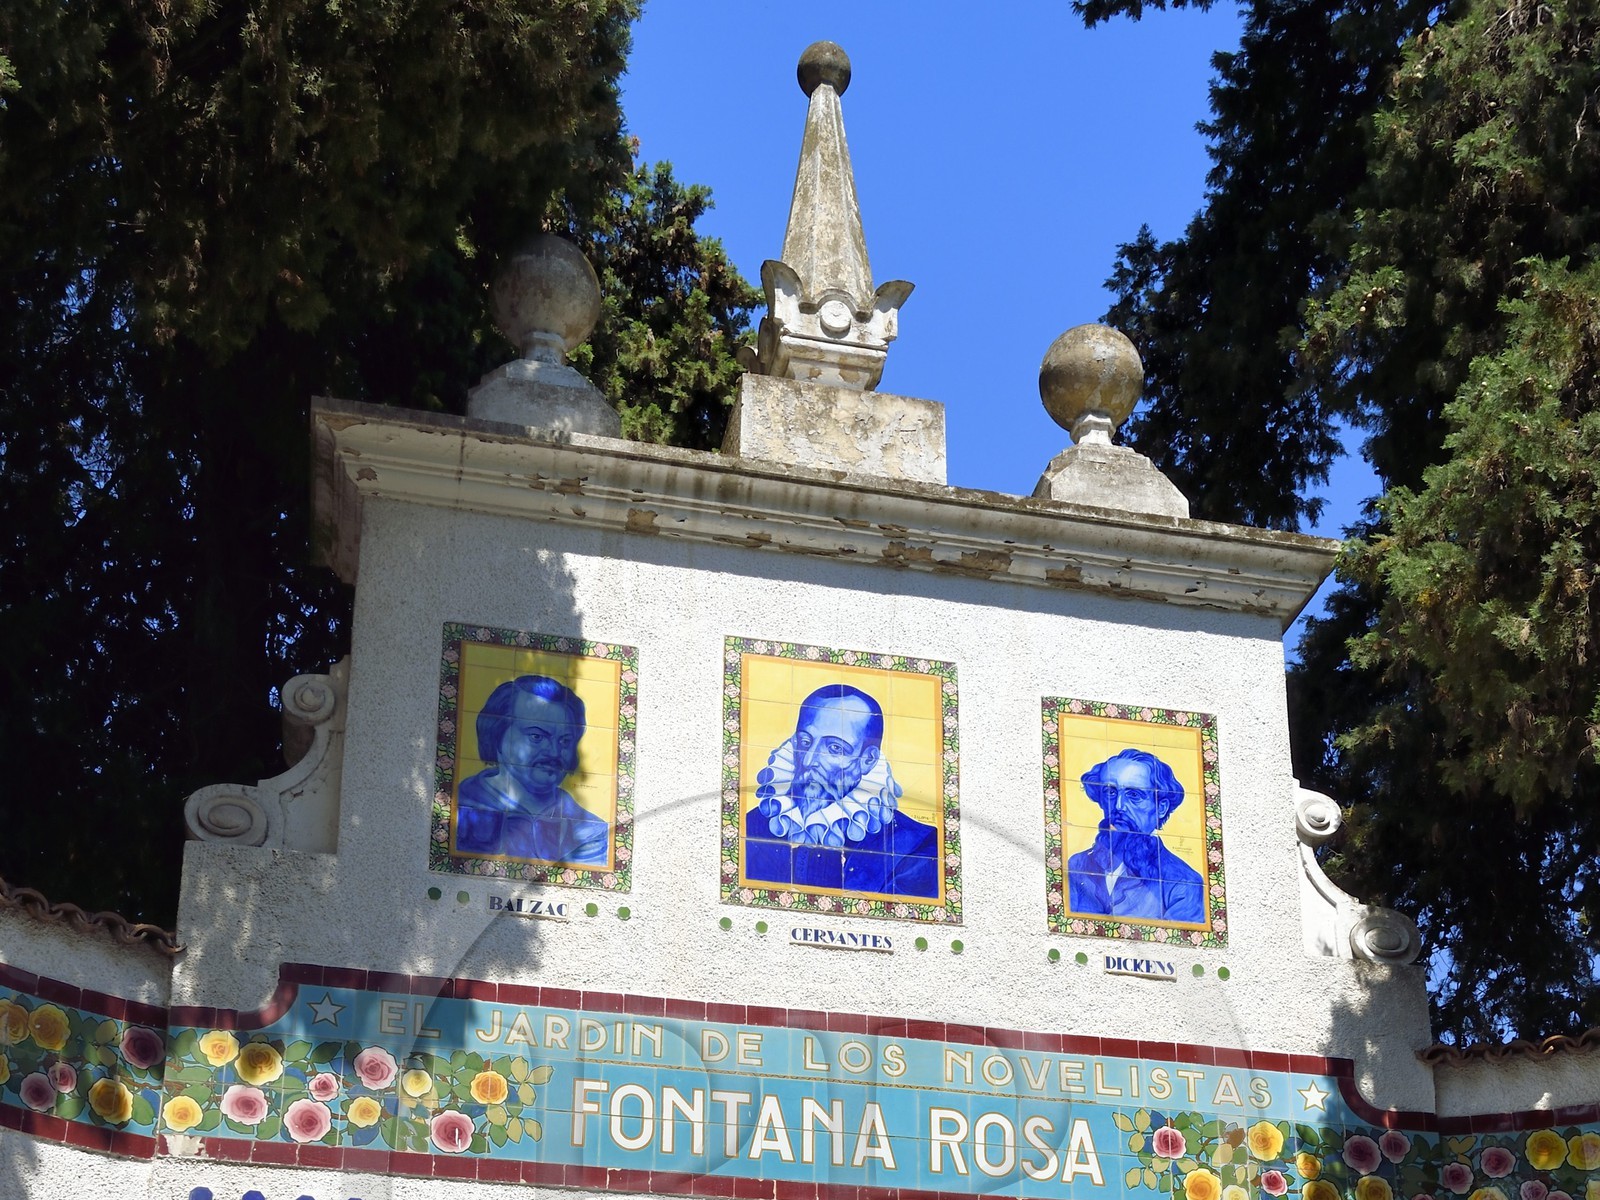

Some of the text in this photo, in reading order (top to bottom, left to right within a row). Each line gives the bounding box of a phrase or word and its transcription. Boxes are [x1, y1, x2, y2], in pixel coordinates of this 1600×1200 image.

[490, 896, 567, 916] BALZAC
[792, 927, 891, 948] CERVANTES
[1106, 956, 1175, 975] DICKENS
[379, 1000, 1272, 1109] EL JARDIN DE LOS NOVELISTAS
[571, 1078, 1106, 1187] FONTANA ROSA
